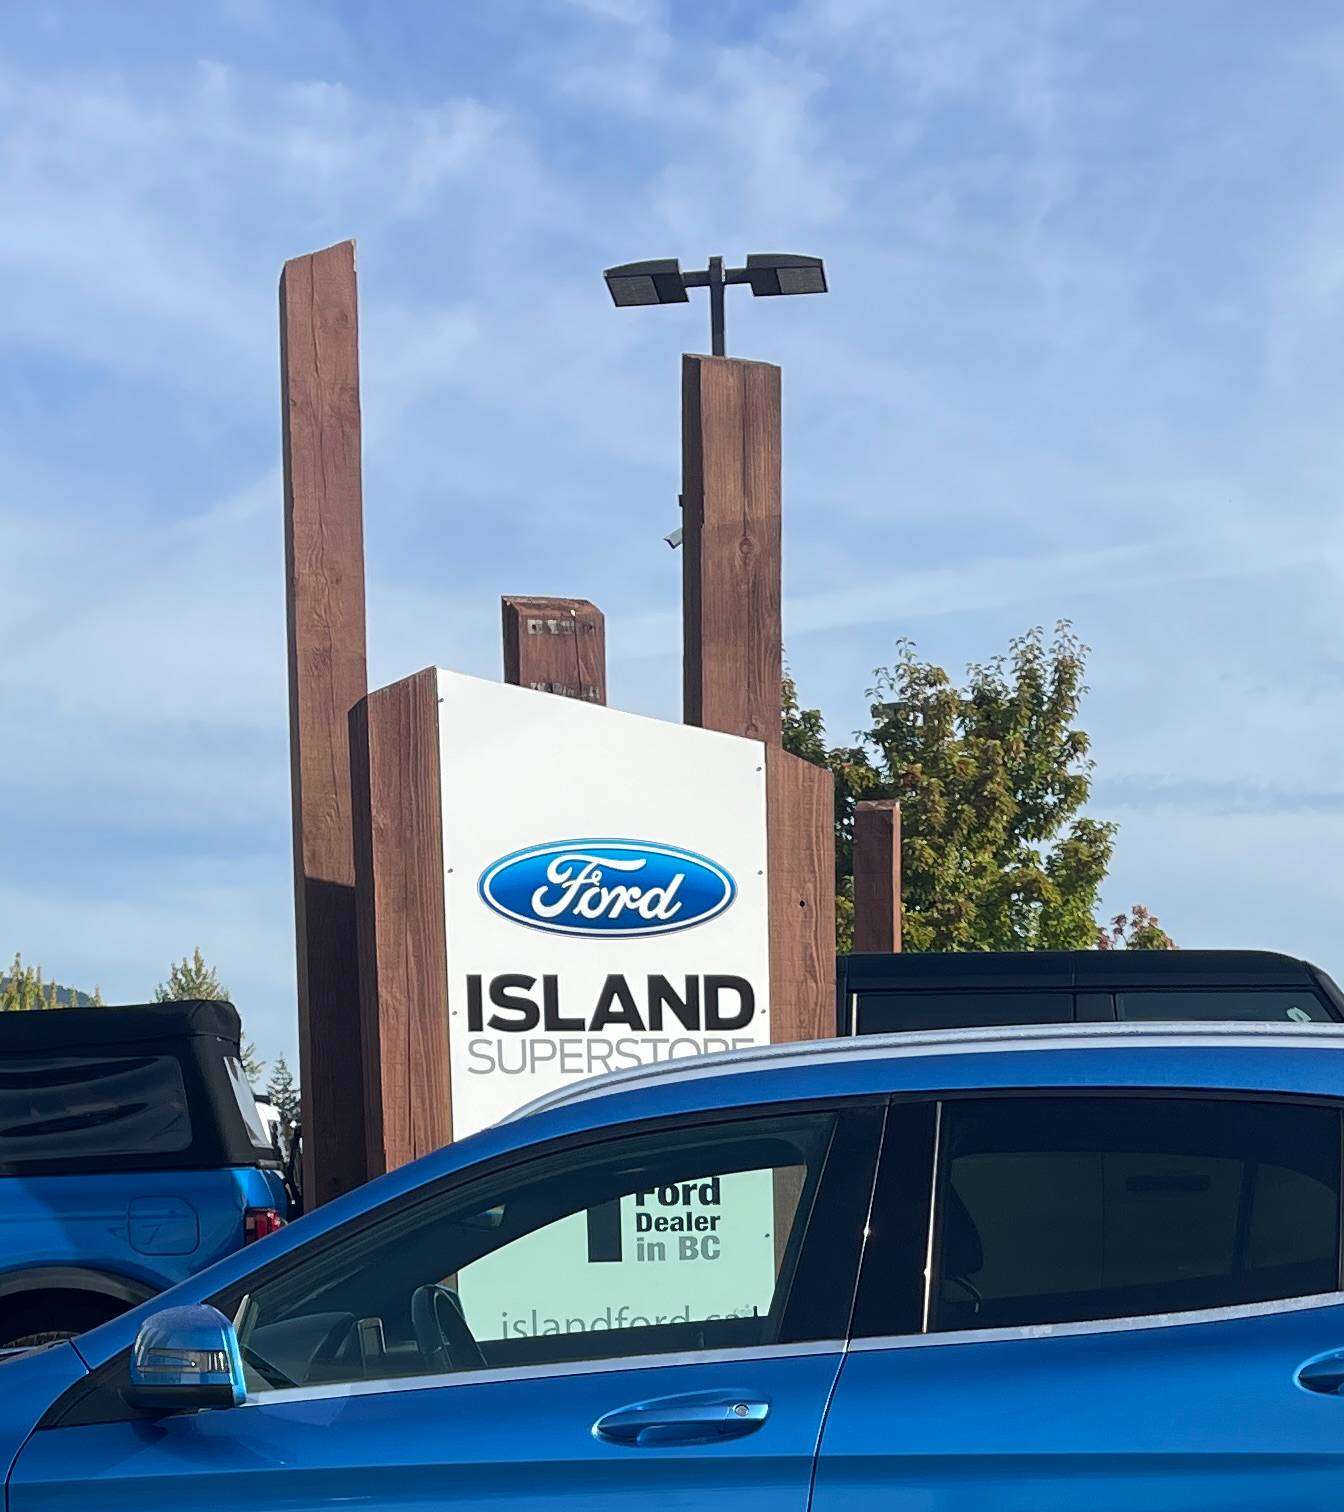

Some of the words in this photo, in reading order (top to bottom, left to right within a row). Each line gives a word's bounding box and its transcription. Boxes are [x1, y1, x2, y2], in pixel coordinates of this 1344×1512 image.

[531, 854, 685, 920] Ford
[466, 973, 755, 1033] ISLAND
[636, 1211, 721, 1232] Dealer
[636, 1237, 666, 1262] in
[678, 1235, 721, 1261] BC
